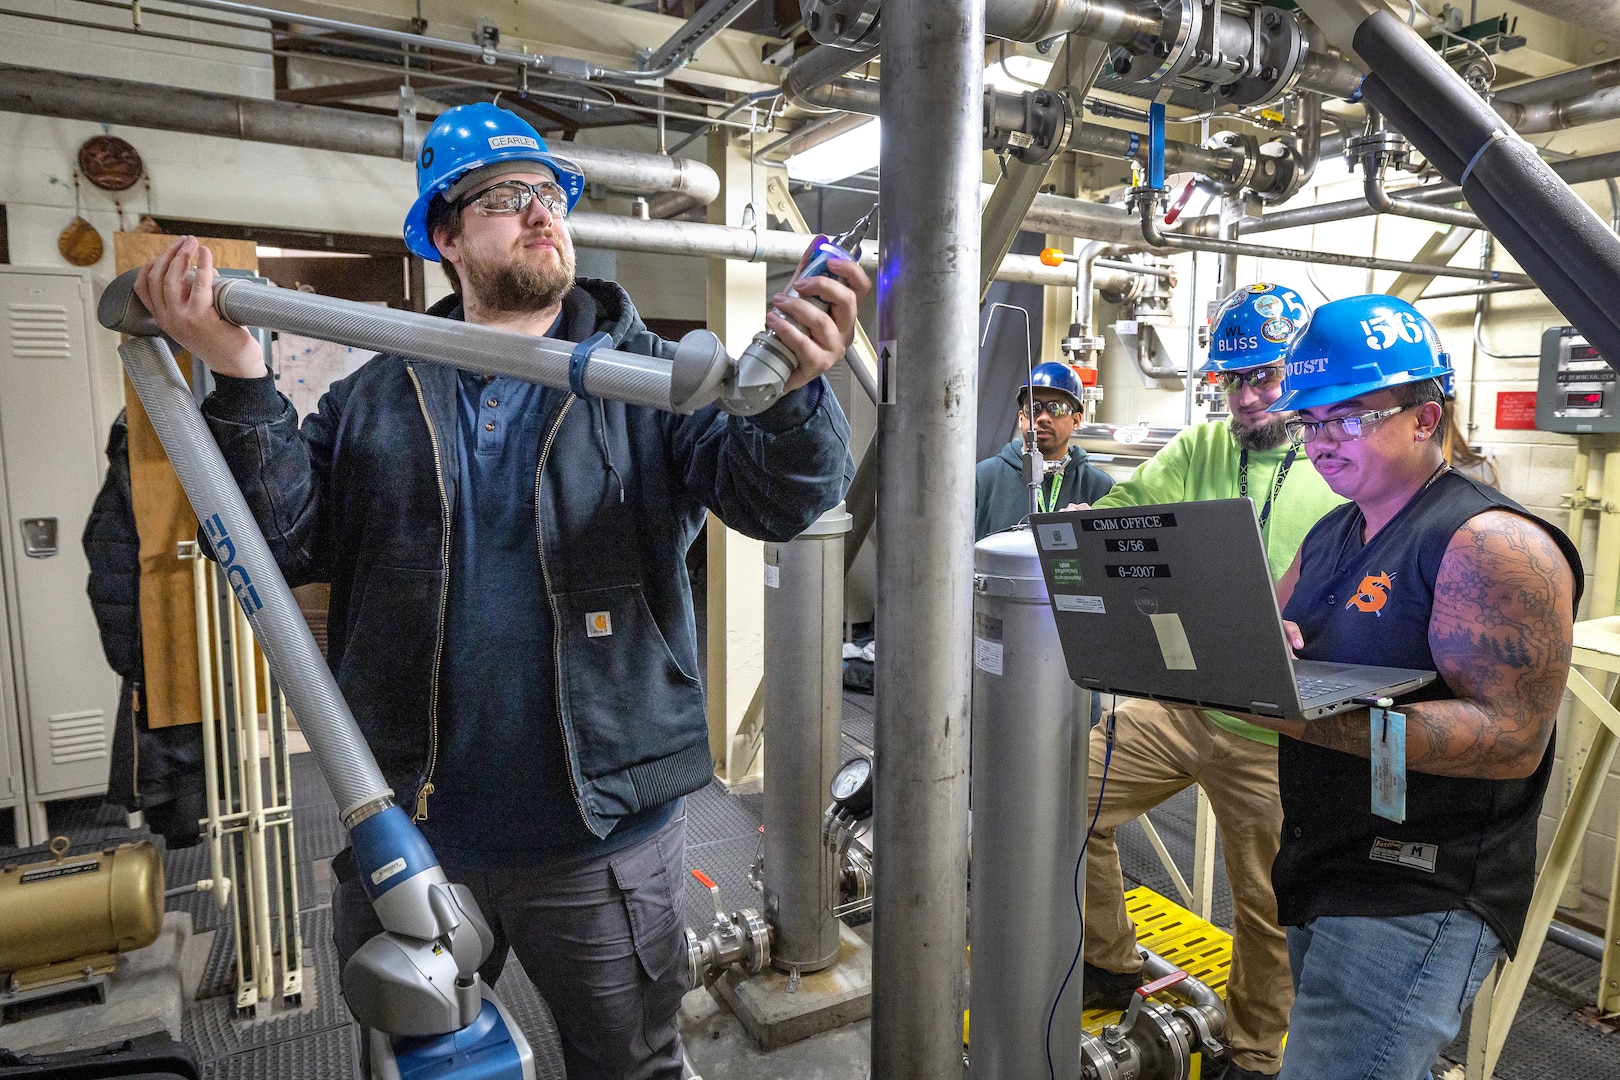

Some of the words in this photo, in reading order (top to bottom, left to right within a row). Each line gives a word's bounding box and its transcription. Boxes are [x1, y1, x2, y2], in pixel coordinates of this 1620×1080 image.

[491, 136, 537, 148] CEARLEY
[1226, 325, 1245, 337] WL
[1360, 311, 1423, 350] 56
[1218, 336, 1258, 352] BLISS
[1285, 357, 1329, 377] OUST
[1092, 518, 1118, 531] CMM
[1120, 515, 1162, 529] OFFICE
[1117, 539, 1144, 552] S/56
[203, 512, 263, 617] EDGE
[1118, 566, 1156, 577] 6-2007
[1411, 846, 1423, 857] M
